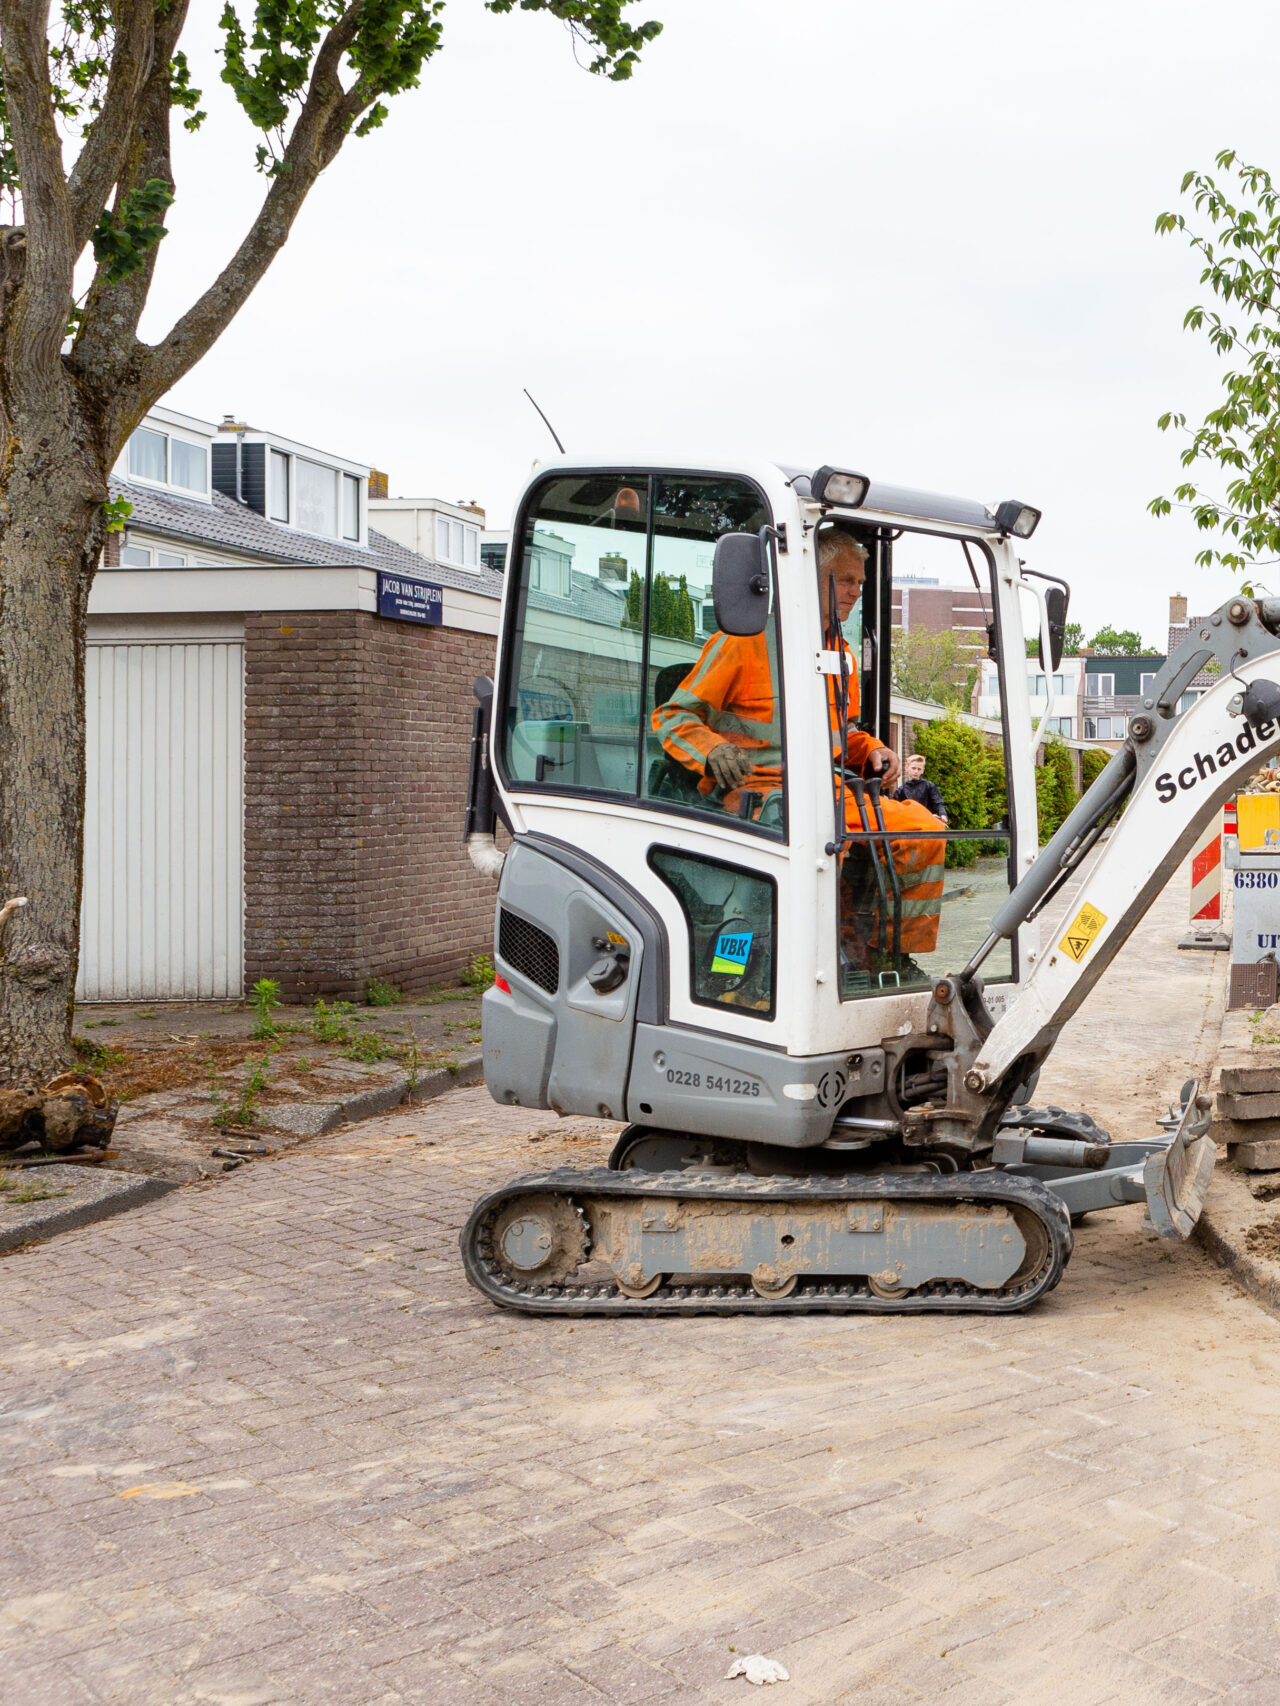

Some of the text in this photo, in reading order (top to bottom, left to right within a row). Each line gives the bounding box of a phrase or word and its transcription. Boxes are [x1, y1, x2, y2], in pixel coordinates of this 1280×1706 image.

[382, 578, 400, 595] JACOB
[401, 582, 413, 597] VAN
[414, 585, 442, 604] STRIJPLEIN
[1234, 872, 1278, 888] 6380
[721, 938, 748, 956] VBK
[666, 1069, 760, 1097] 0228 541225
